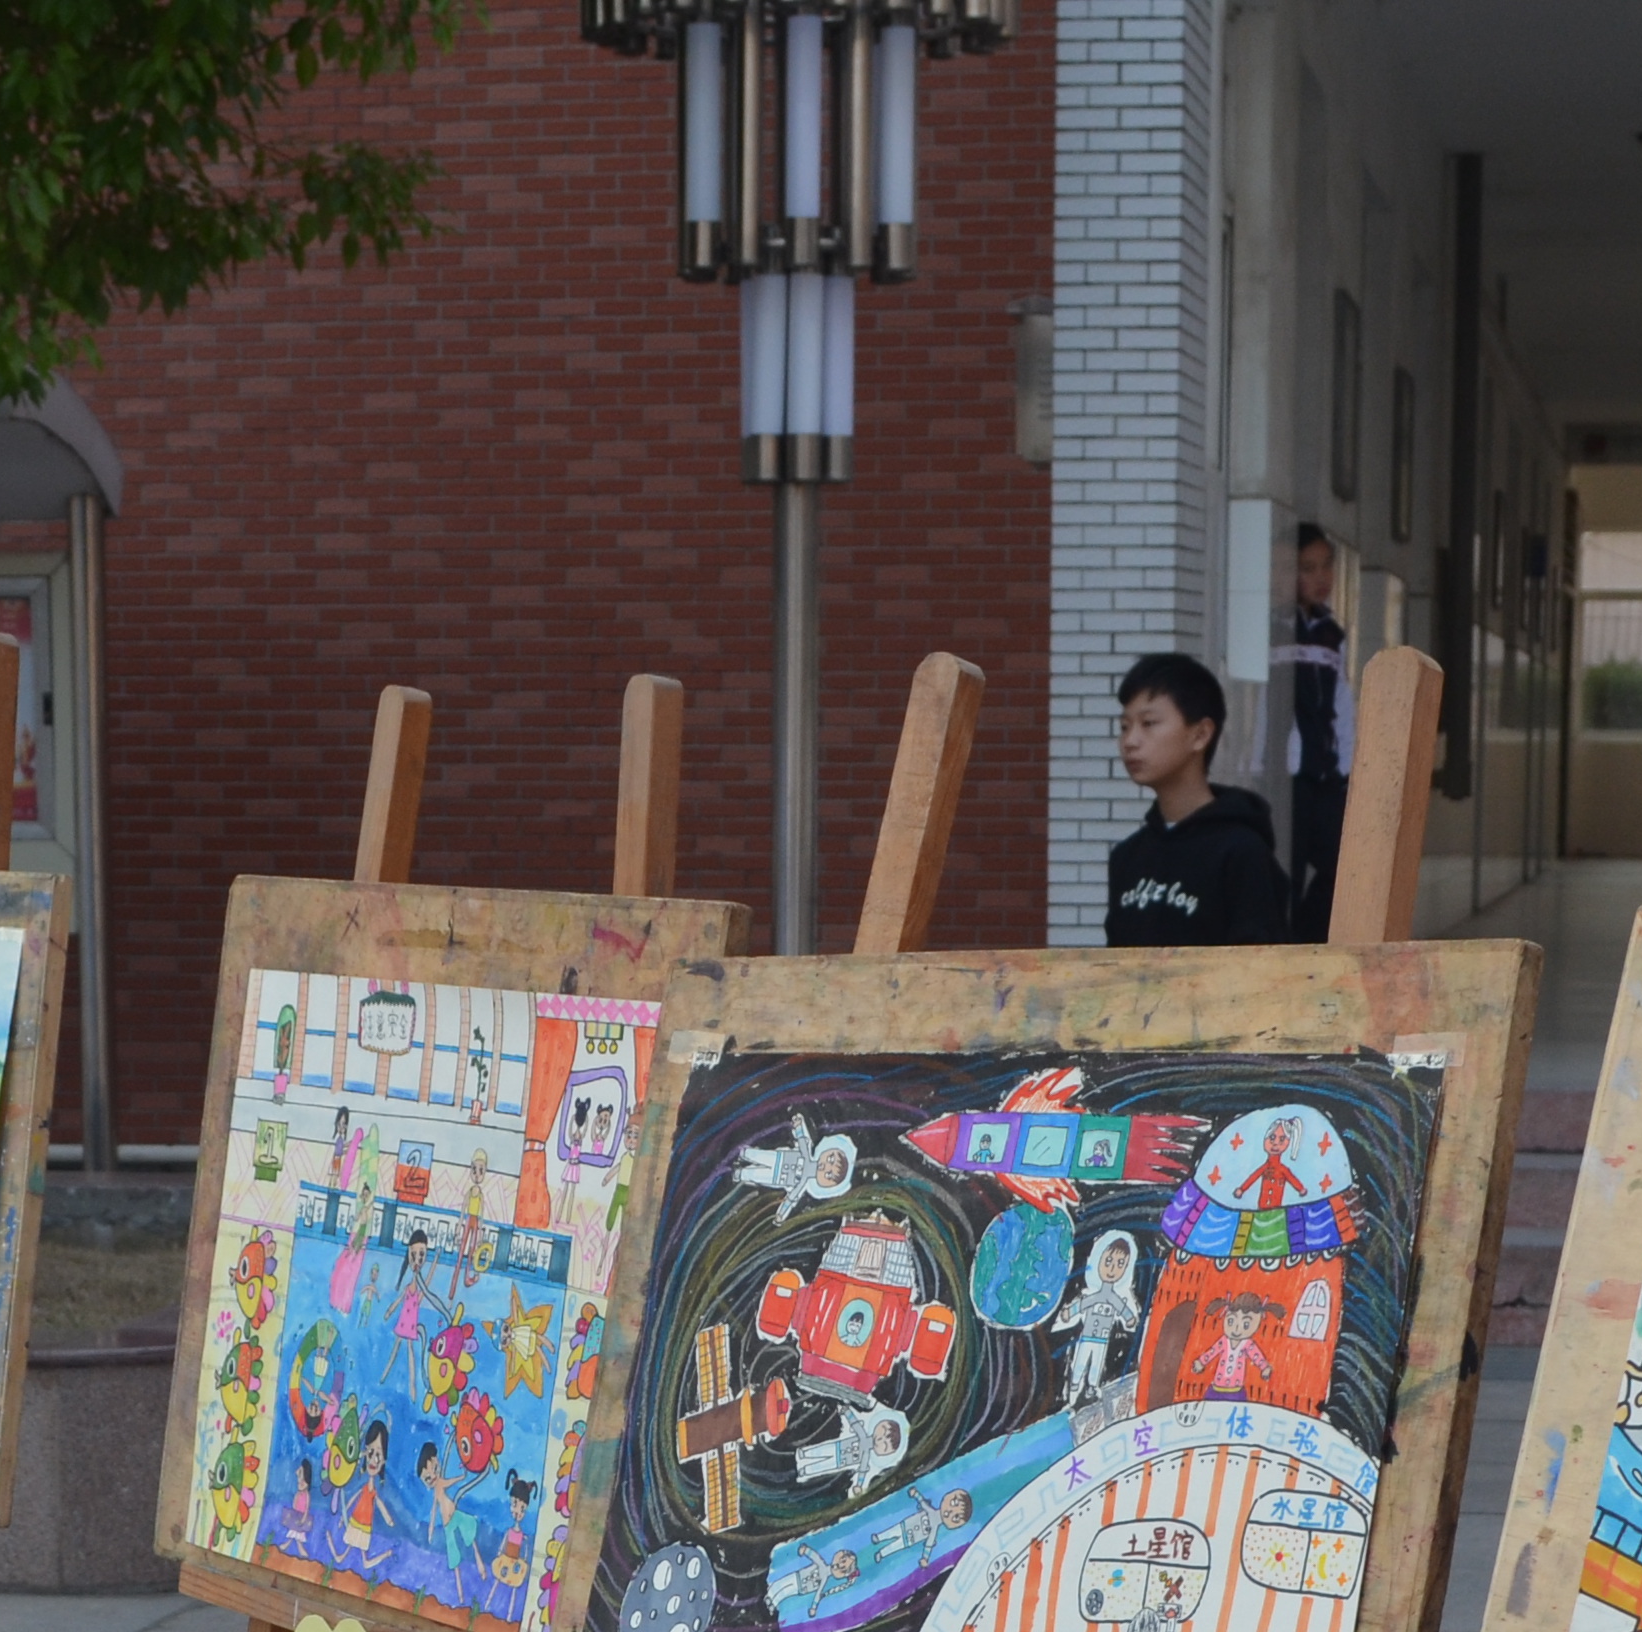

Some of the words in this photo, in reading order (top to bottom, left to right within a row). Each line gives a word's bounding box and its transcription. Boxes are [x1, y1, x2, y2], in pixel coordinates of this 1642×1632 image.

[258, 1126, 278, 1164] 1
[403, 1149, 426, 1188] 2
[1271, 1497, 1348, 1530] 水星馆
[1122, 1526, 1195, 1560] 土星馆
